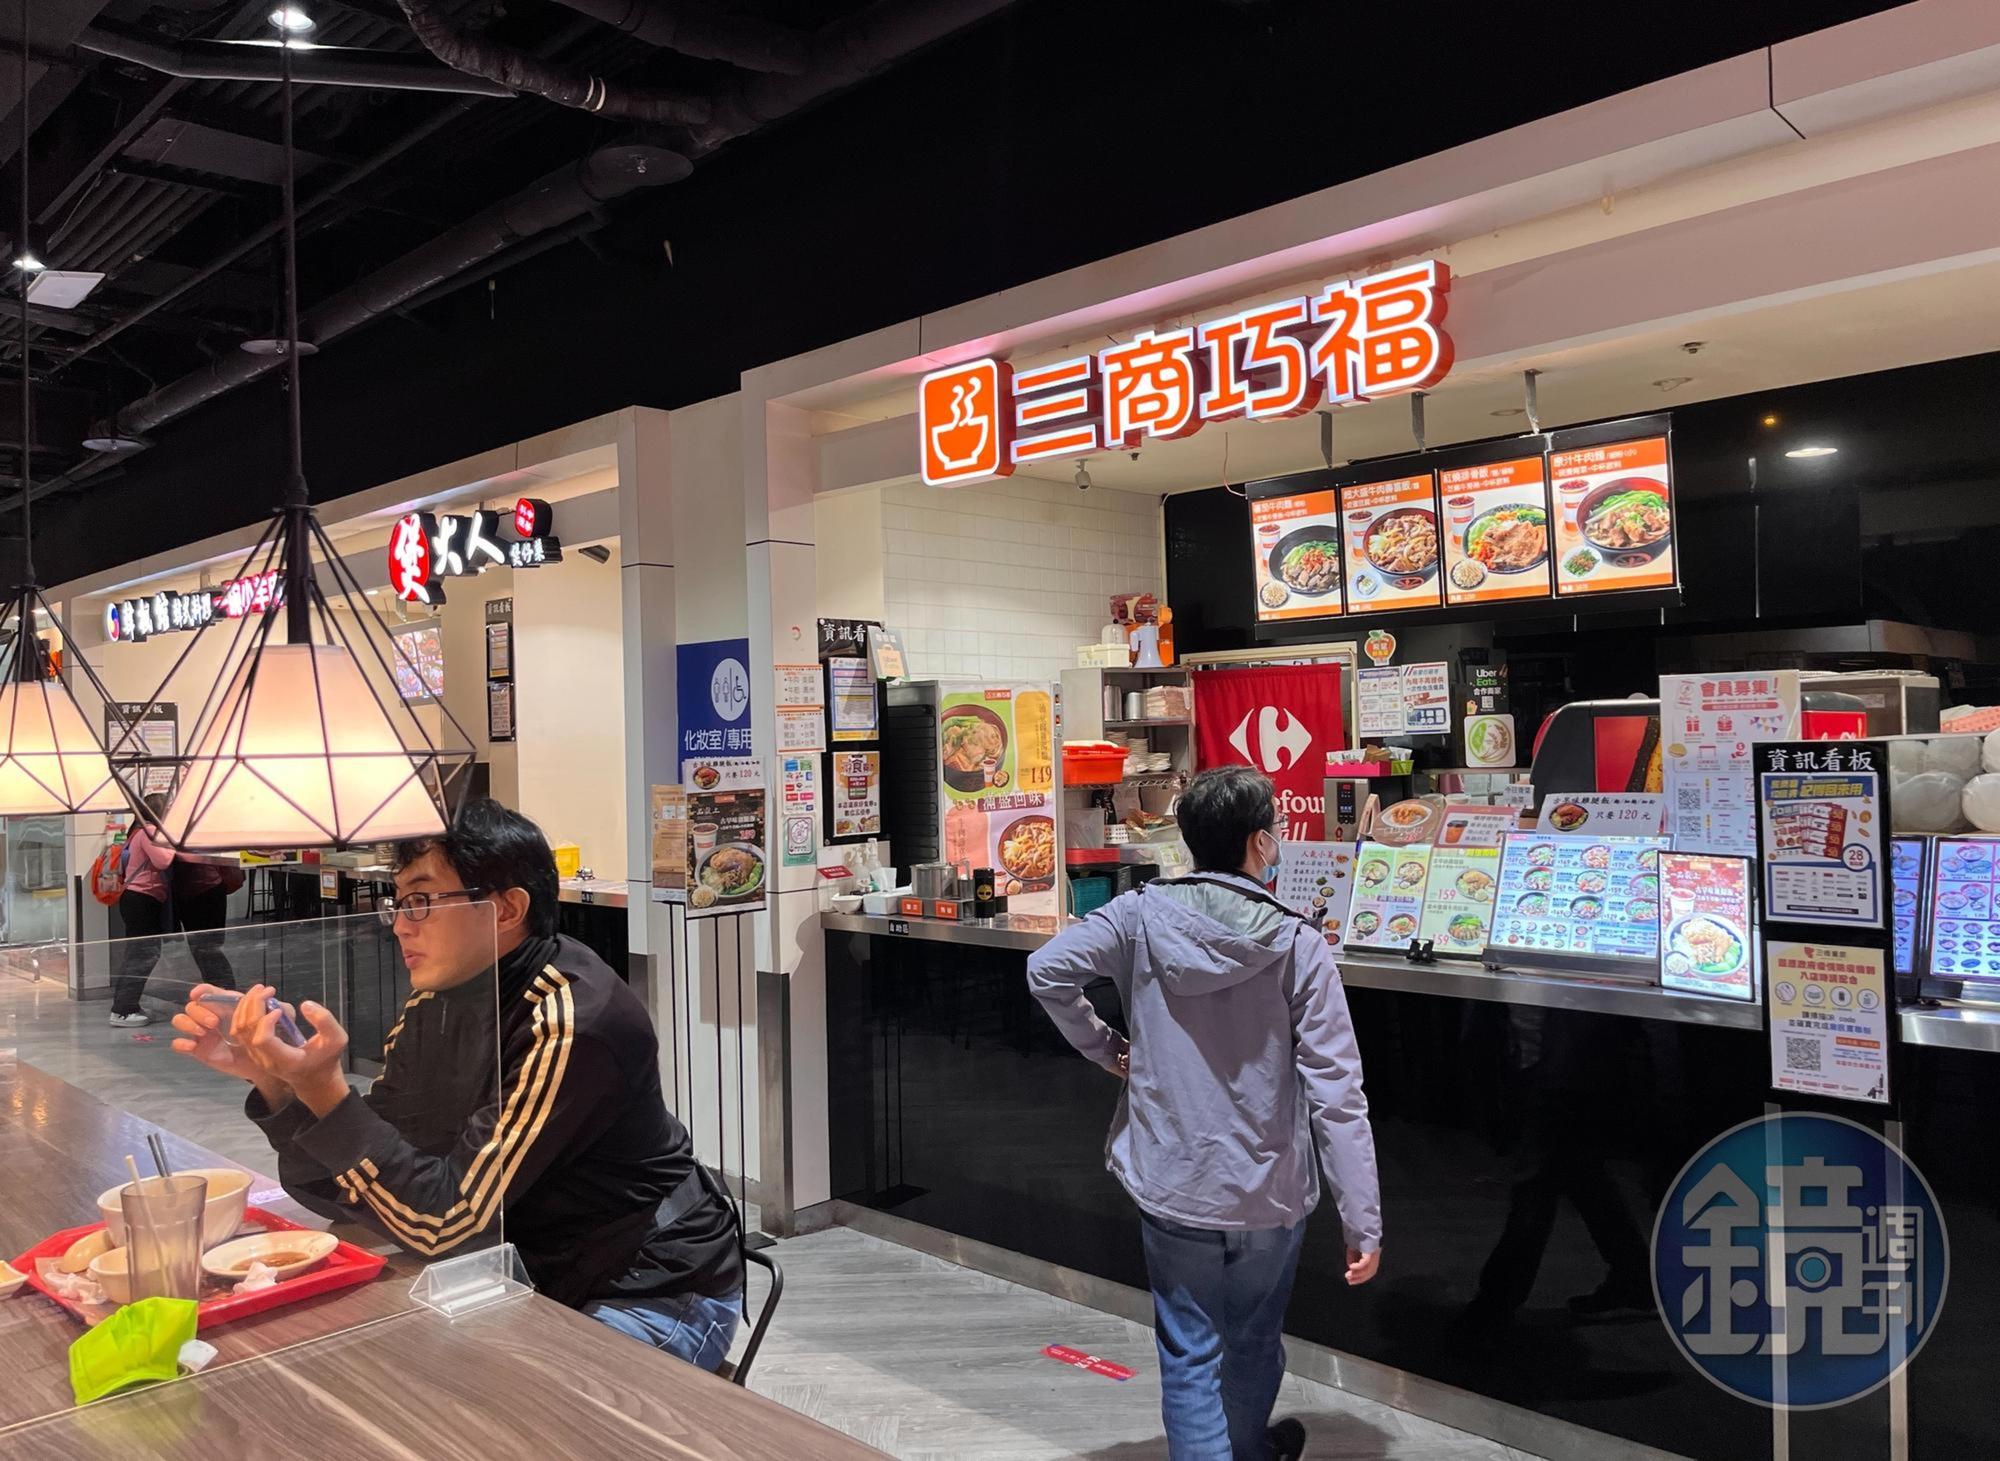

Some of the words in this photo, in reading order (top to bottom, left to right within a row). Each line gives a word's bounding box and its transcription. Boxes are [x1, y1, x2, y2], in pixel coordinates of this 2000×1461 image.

[1010, 261, 1441, 463] 三商巧福
[1476, 669, 1497, 677] Uber
[1476, 678, 1498, 686] Eats
[684, 728, 752, 751] 化妝室/專用
[1768, 747, 1875, 772] 資訊看板
[739, 769, 752, 778] 120
[1618, 809, 1638, 820] 120
[1642, 812, 1651, 820] 元
[1849, 850, 1863, 861] 28
[1439, 888, 1456, 900] 159
